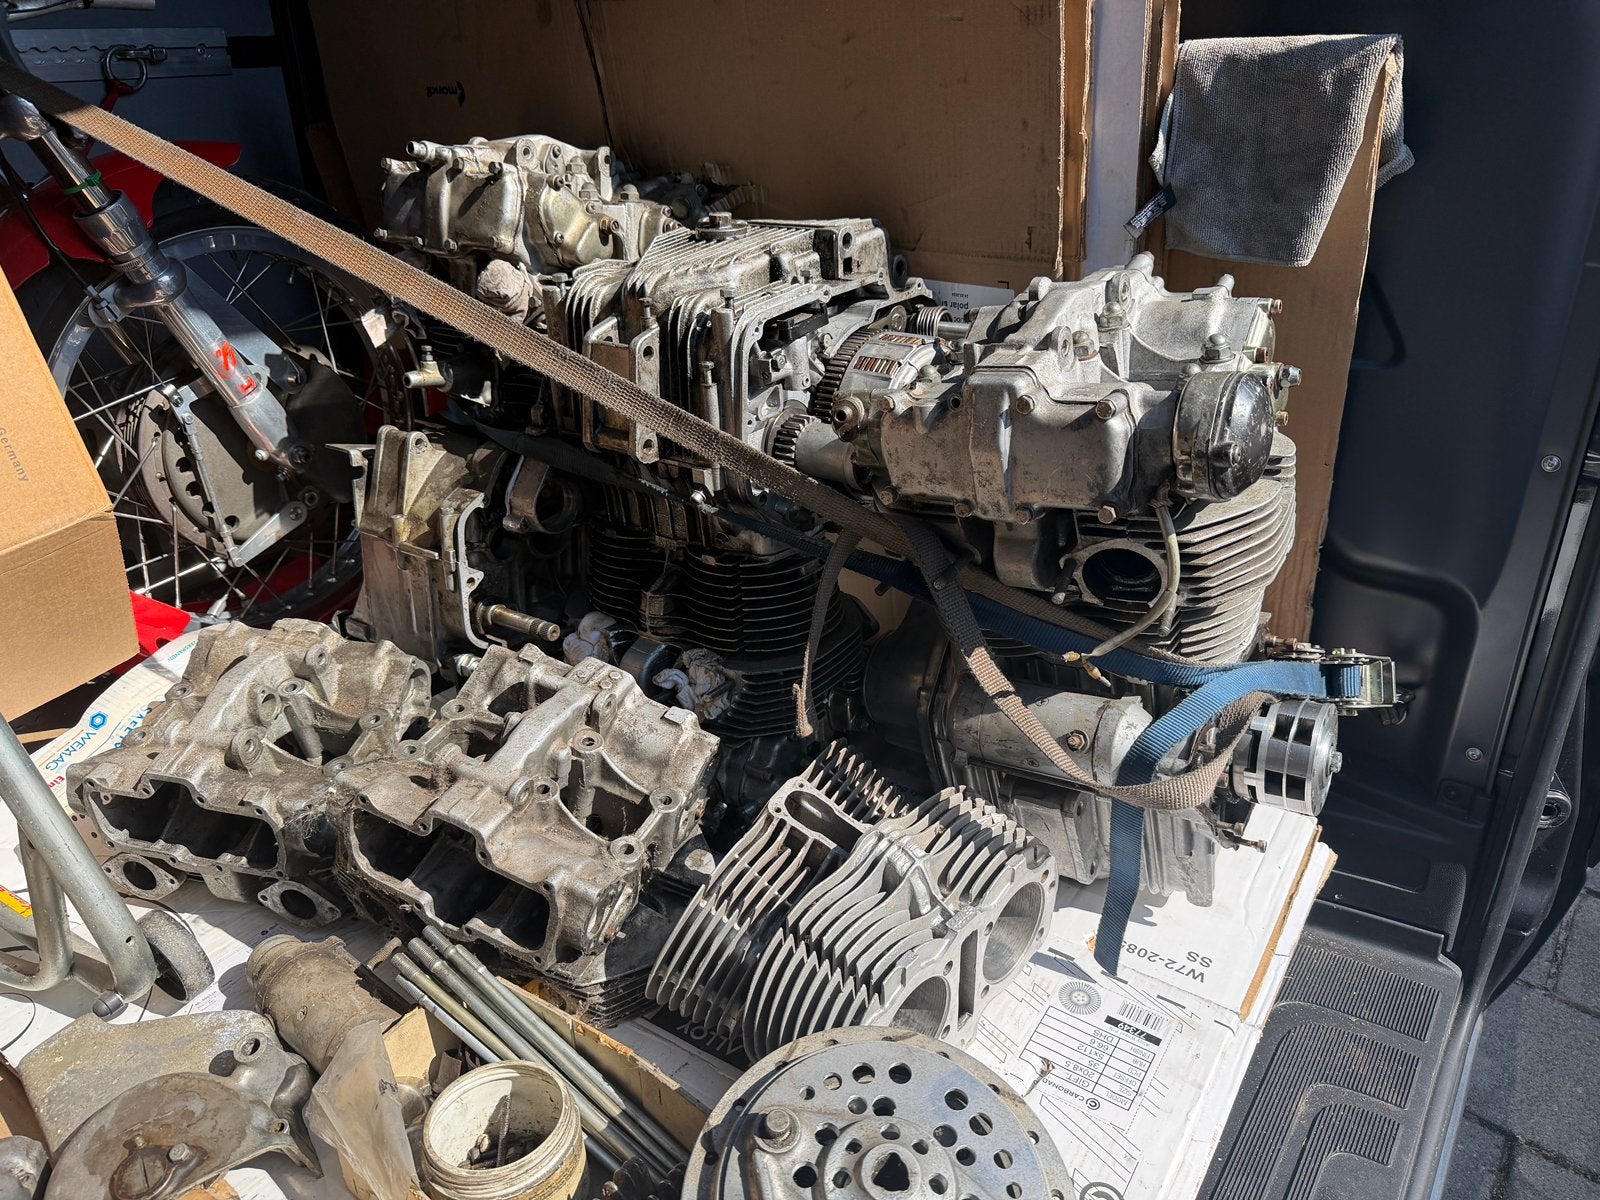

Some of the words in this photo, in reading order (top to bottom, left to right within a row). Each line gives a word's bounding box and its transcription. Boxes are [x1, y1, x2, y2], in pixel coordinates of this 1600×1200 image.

[46, 732, 97, 770] WEMAG
[1185, 951, 1213, 968] SS
[1093, 1029, 1114, 1043] DHS
[1117, 1023, 1147, 1040] 77349
[1089, 1038, 1109, 1051] 66.6
[1077, 1044, 1105, 1061] 5x112
[1065, 1060, 1095, 1078] 20x8.5
[1088, 1060, 1100, 1070] 35
[1132, 1058, 1147, 1068] HUB
[1113, 1071, 1137, 1087] OFFSET
[1127, 1067, 1142, 1078] PCD
[1106, 1091, 1128, 1106] MODEL
[1119, 1085, 1132, 1097] SIZE
